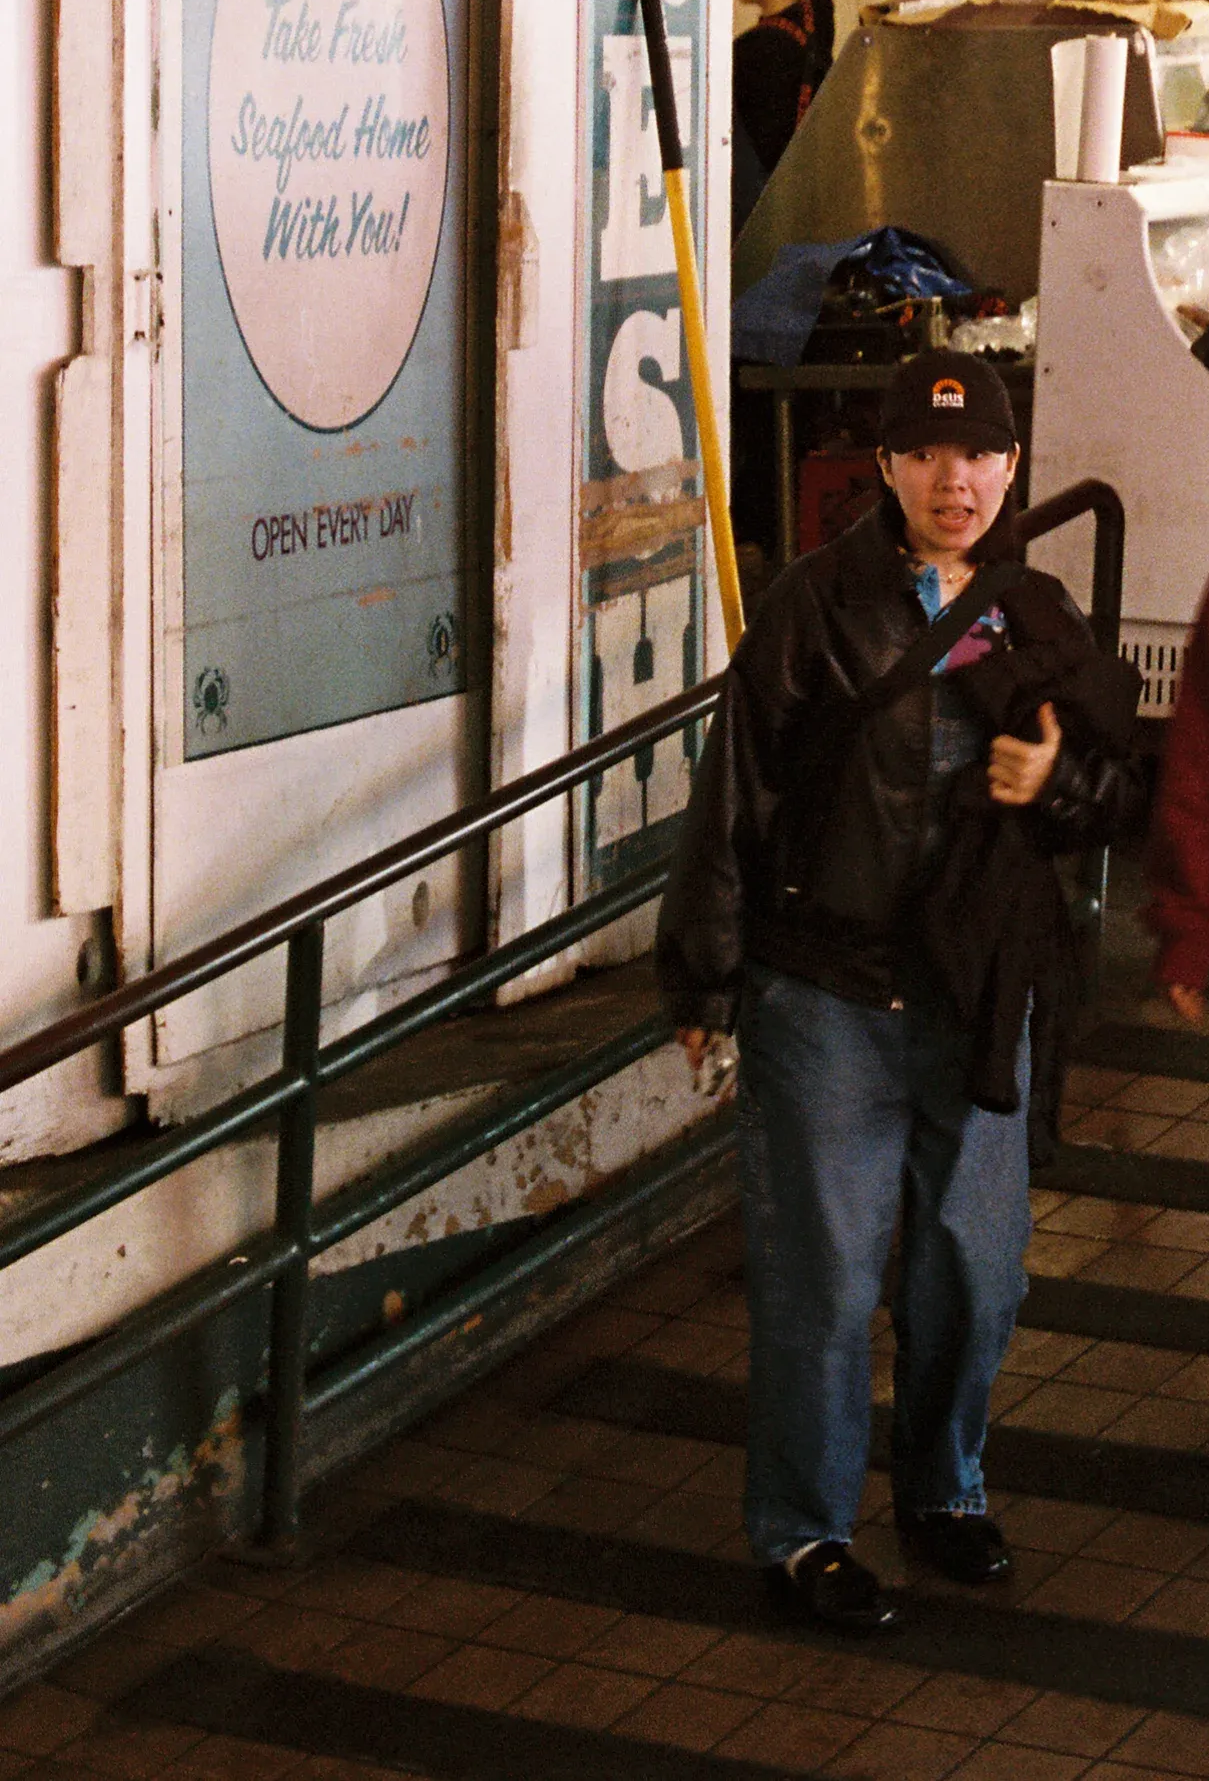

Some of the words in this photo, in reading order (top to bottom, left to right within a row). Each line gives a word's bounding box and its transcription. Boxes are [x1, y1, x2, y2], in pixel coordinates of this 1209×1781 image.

[230, 89, 350, 195] Seafood
[353, 92, 431, 160] Home
[262, 194, 341, 260] With
[345, 190, 411, 257] You!
[251, 510, 308, 562] OPEN
[314, 501, 370, 550] EVERY
[379, 491, 418, 539] DAY
